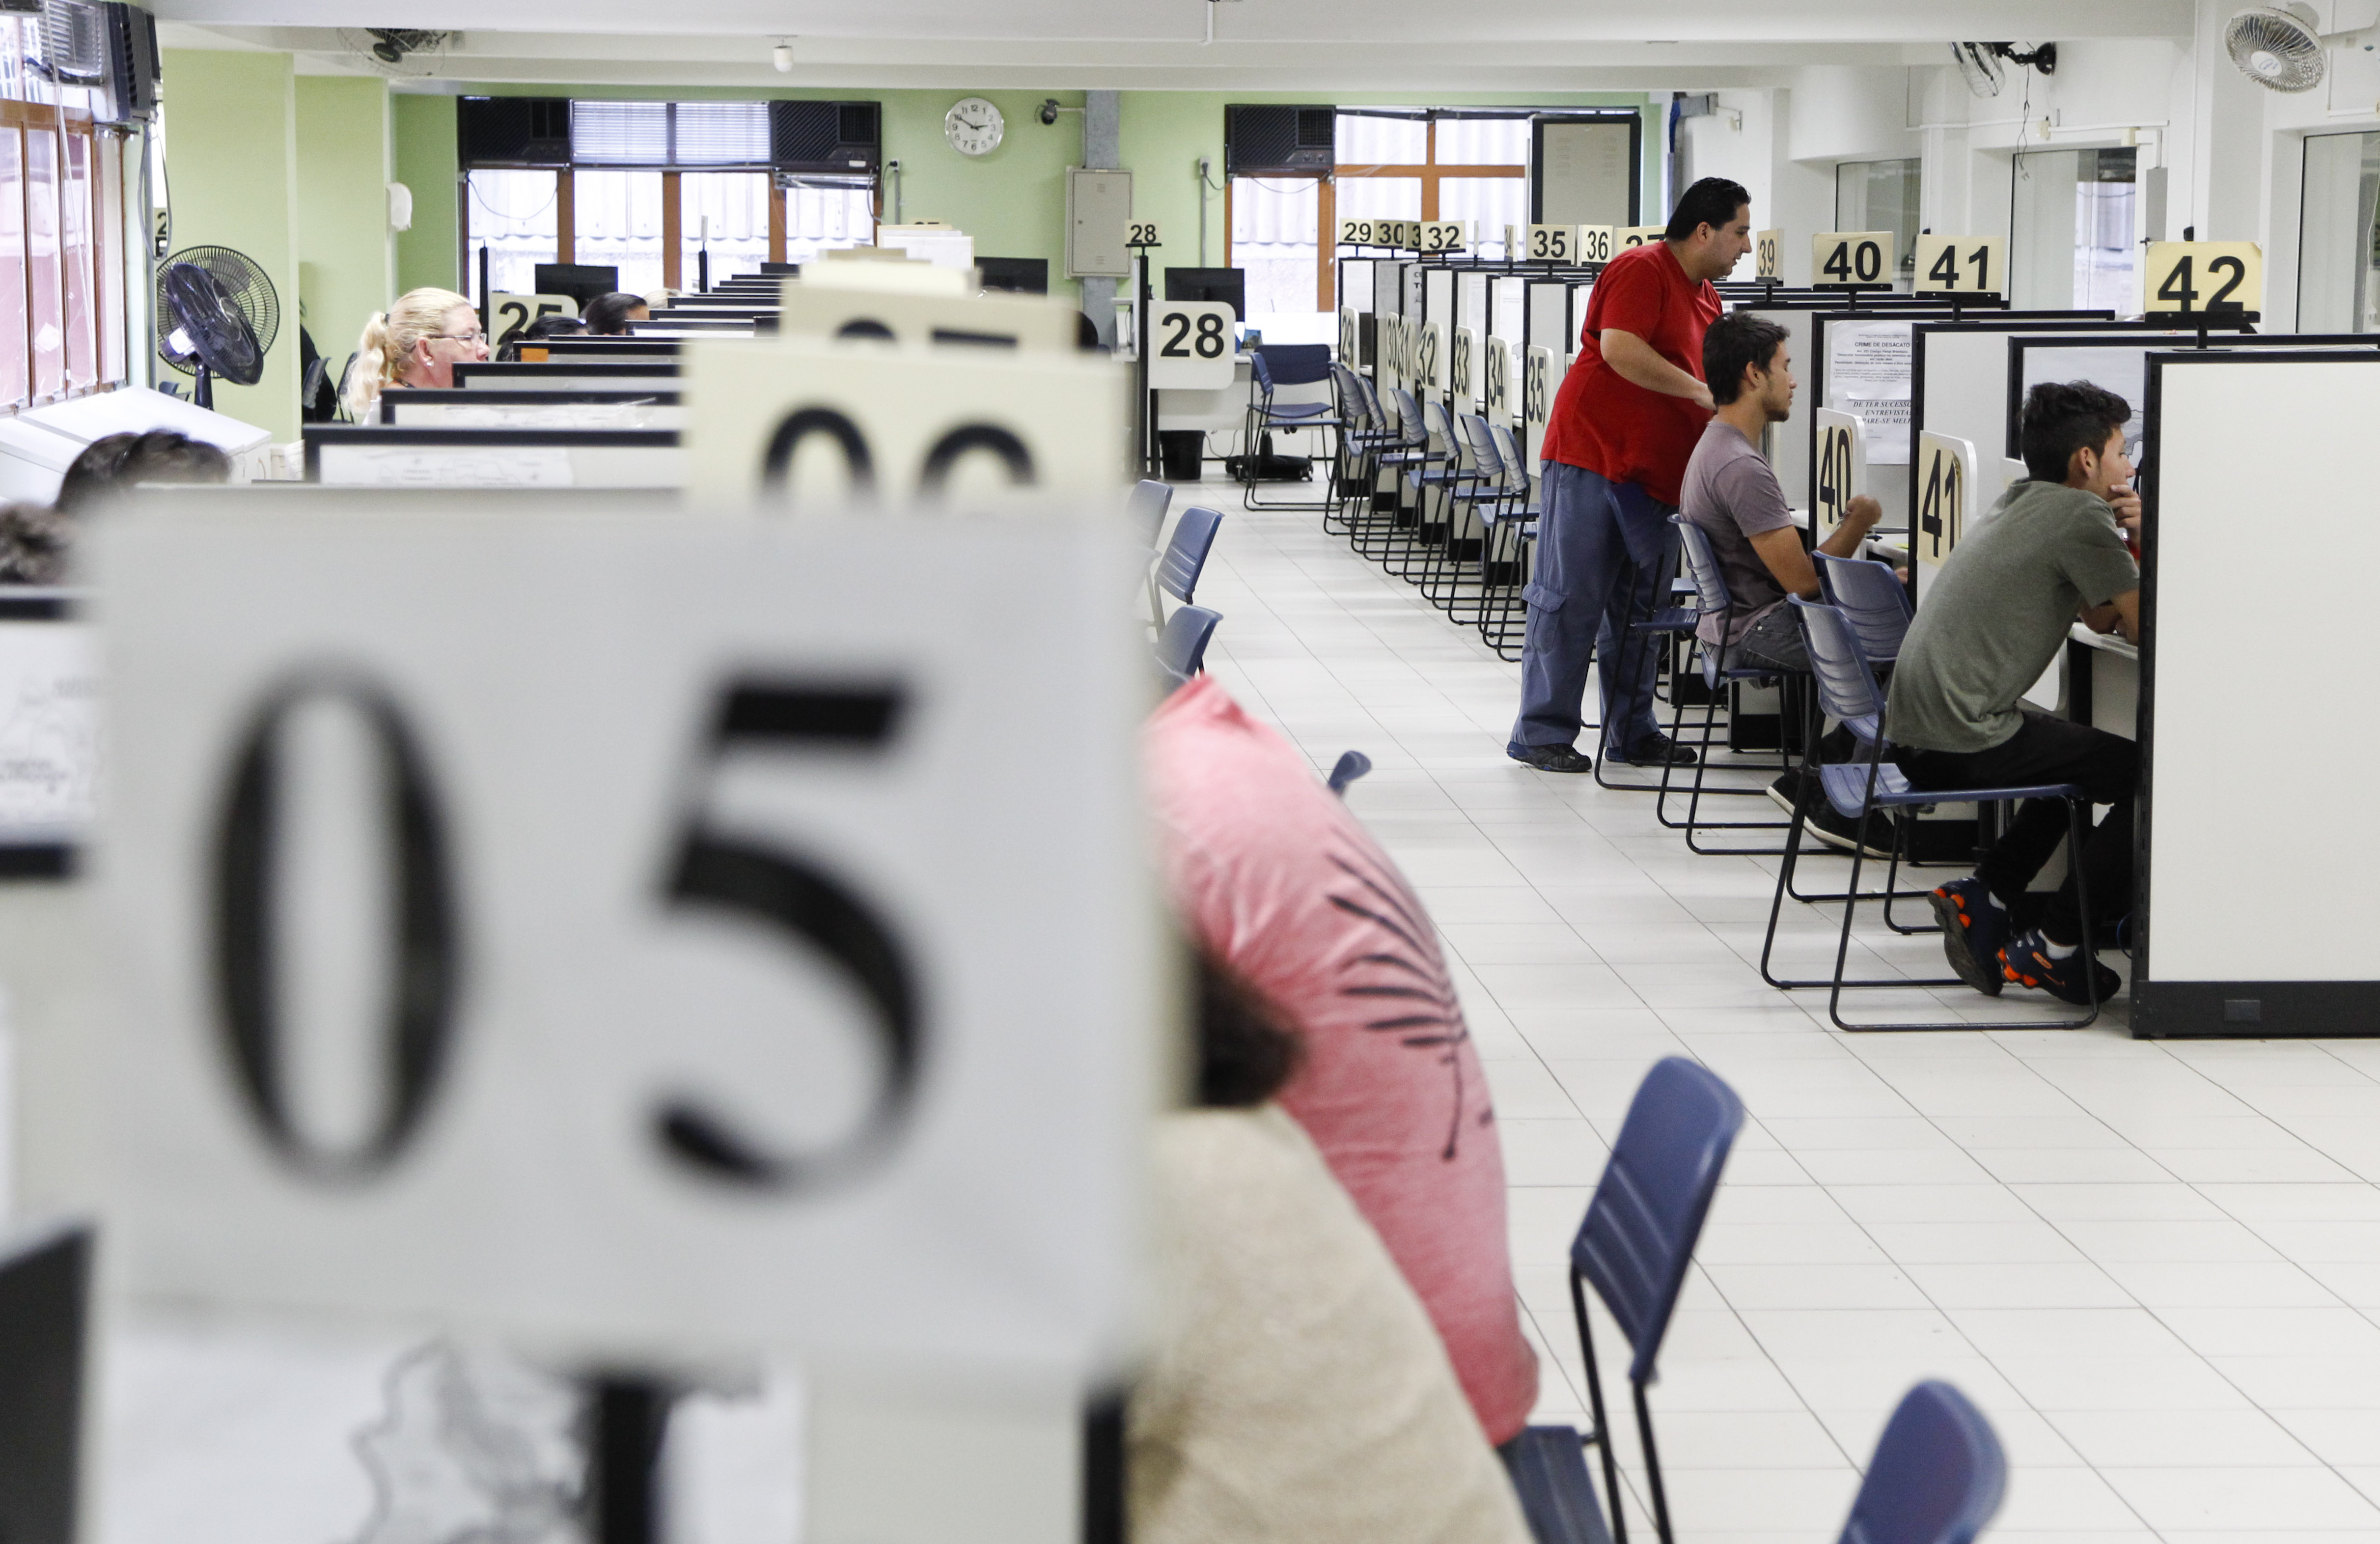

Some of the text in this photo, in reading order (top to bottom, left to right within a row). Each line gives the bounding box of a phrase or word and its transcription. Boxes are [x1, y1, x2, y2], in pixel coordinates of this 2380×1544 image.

[1130, 224, 1157, 243] 28
[1344, 223, 1372, 242] 29
[1379, 223, 1404, 245] 30
[1411, 225, 1421, 247] 3
[1428, 225, 1460, 249] 32
[1533, 230, 1566, 257] 35
[1587, 230, 1608, 260] 36
[1759, 239, 1775, 276] 39
[1823, 241, 1882, 282] 40
[1929, 245, 1989, 290] 41
[2157, 255, 2245, 312] 42
[1160, 312, 1224, 358] 28
[1342, 315, 1353, 365] 29
[1387, 318, 1397, 370] 30
[1399, 322, 1410, 381] 31
[1418, 330, 1436, 387] 32
[1454, 334, 1469, 396] 33
[1489, 344, 1505, 407] 34
[1527, 355, 1545, 423] 35
[1819, 426, 1852, 524] 40
[1922, 449, 1956, 558] 41
[206, 658, 936, 1196] 05
